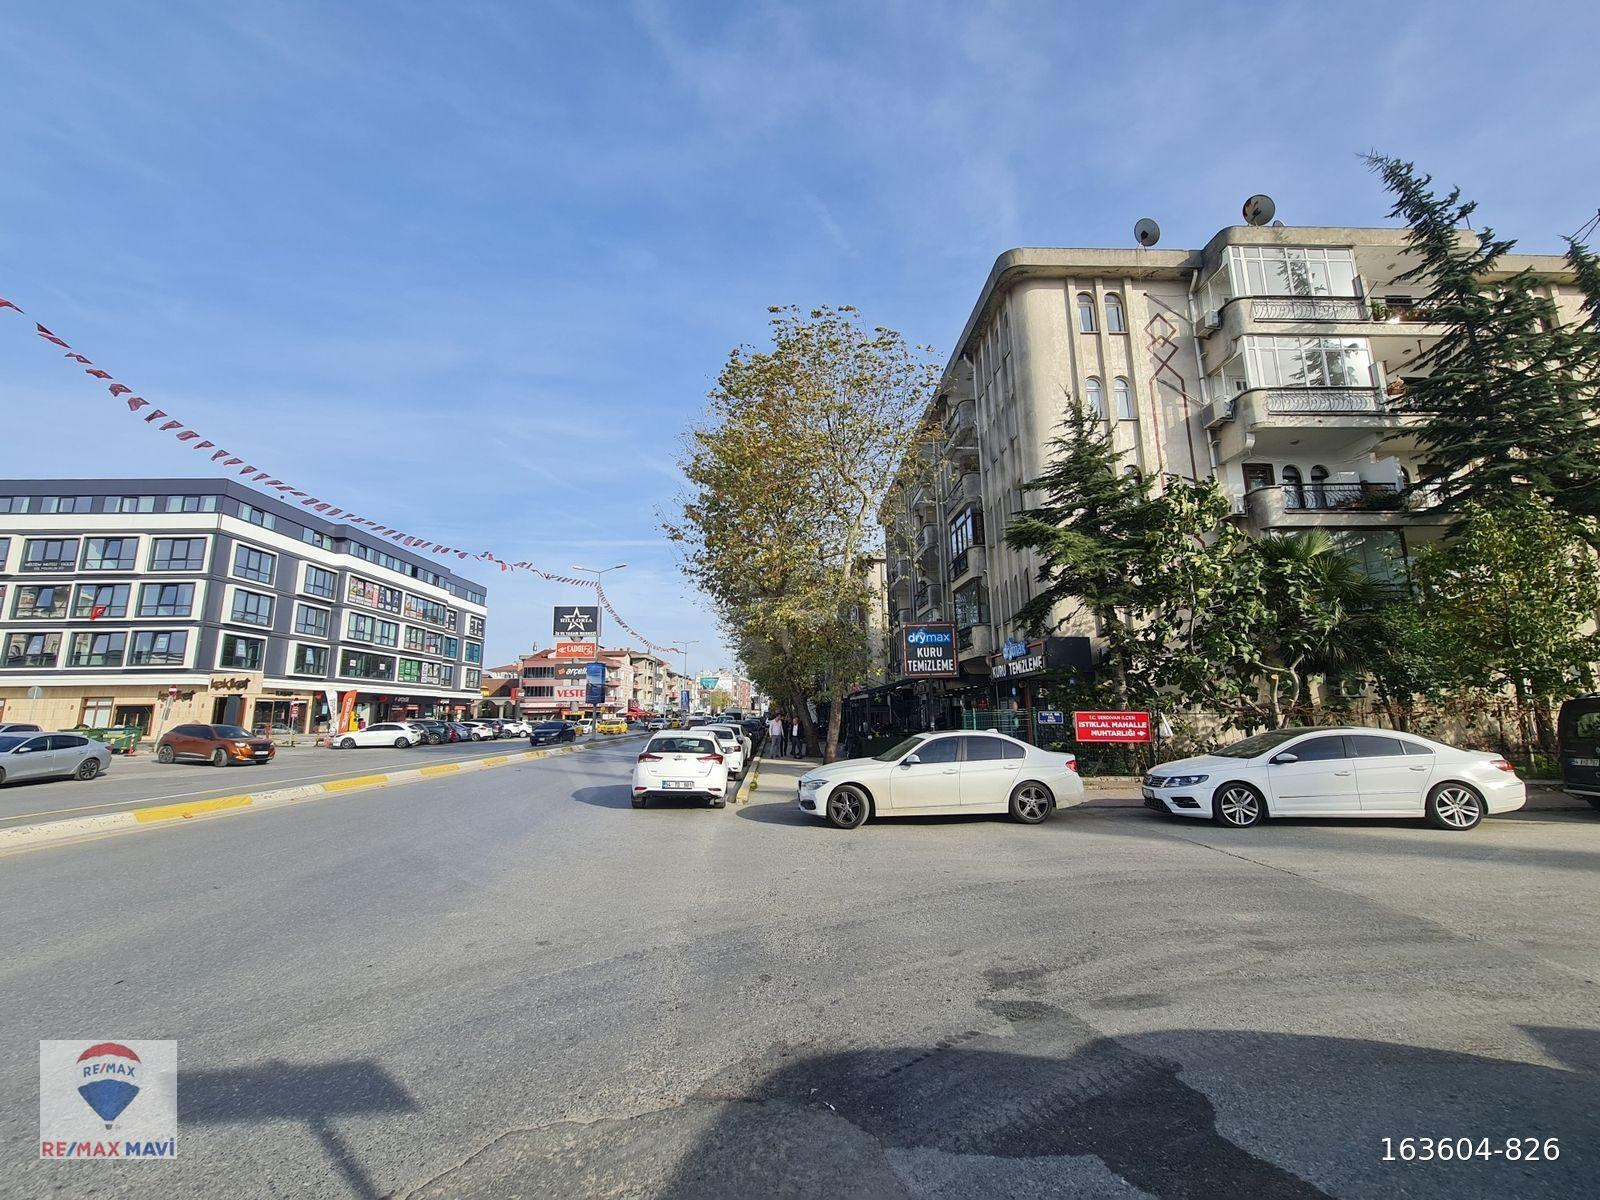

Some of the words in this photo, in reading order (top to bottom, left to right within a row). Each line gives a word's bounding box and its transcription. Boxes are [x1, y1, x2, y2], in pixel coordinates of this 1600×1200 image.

[908, 632, 951, 643] drymax
[917, 647, 943, 658] KURU
[907, 659, 954, 672] TEMİZLEME
[992, 664, 1007, 679] KURU
[557, 689, 586, 697] VESTE
